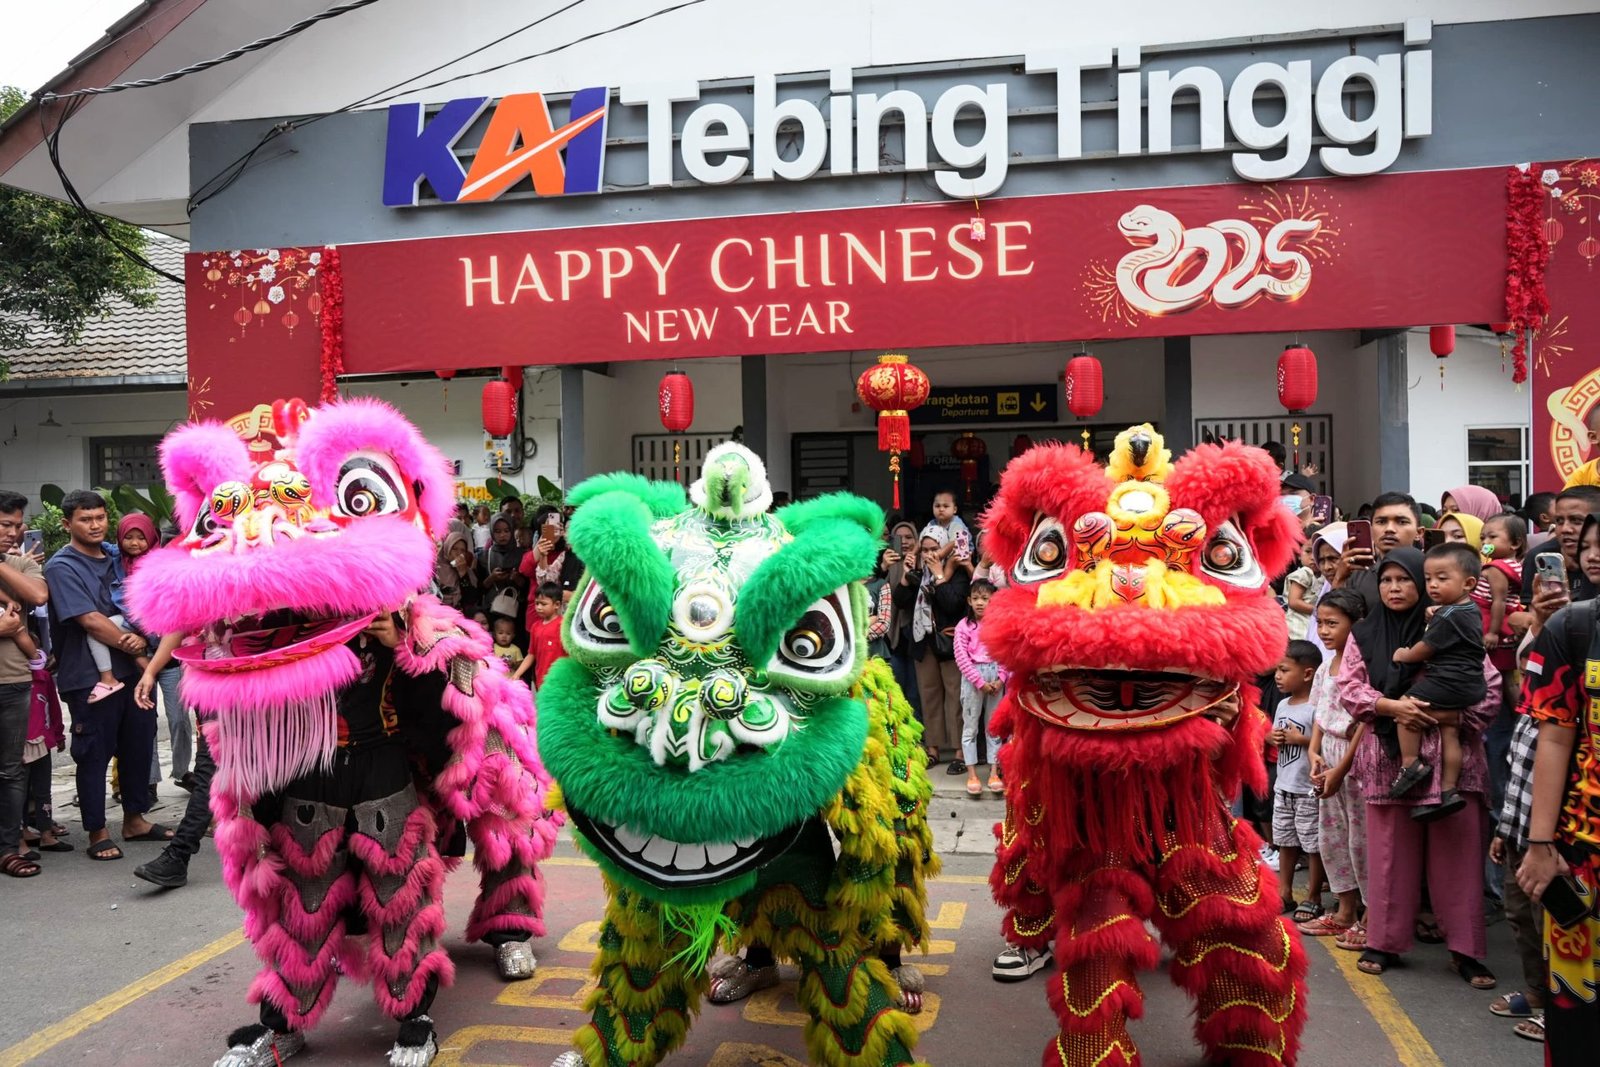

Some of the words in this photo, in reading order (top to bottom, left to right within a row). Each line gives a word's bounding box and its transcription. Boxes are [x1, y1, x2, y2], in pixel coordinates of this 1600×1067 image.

[383, 86, 610, 208] KAI
[620, 67, 1008, 199] Tebing
[1025, 18, 1432, 182] Tinggi
[459, 243, 680, 307] HAPPY
[710, 220, 1035, 293] CHINESE
[1115, 204, 1322, 317] 2025
[623, 307, 719, 344] NEW
[734, 301, 854, 337] YEAR
[926, 394, 989, 407] rangkatan
[942, 408, 989, 418] Departures
